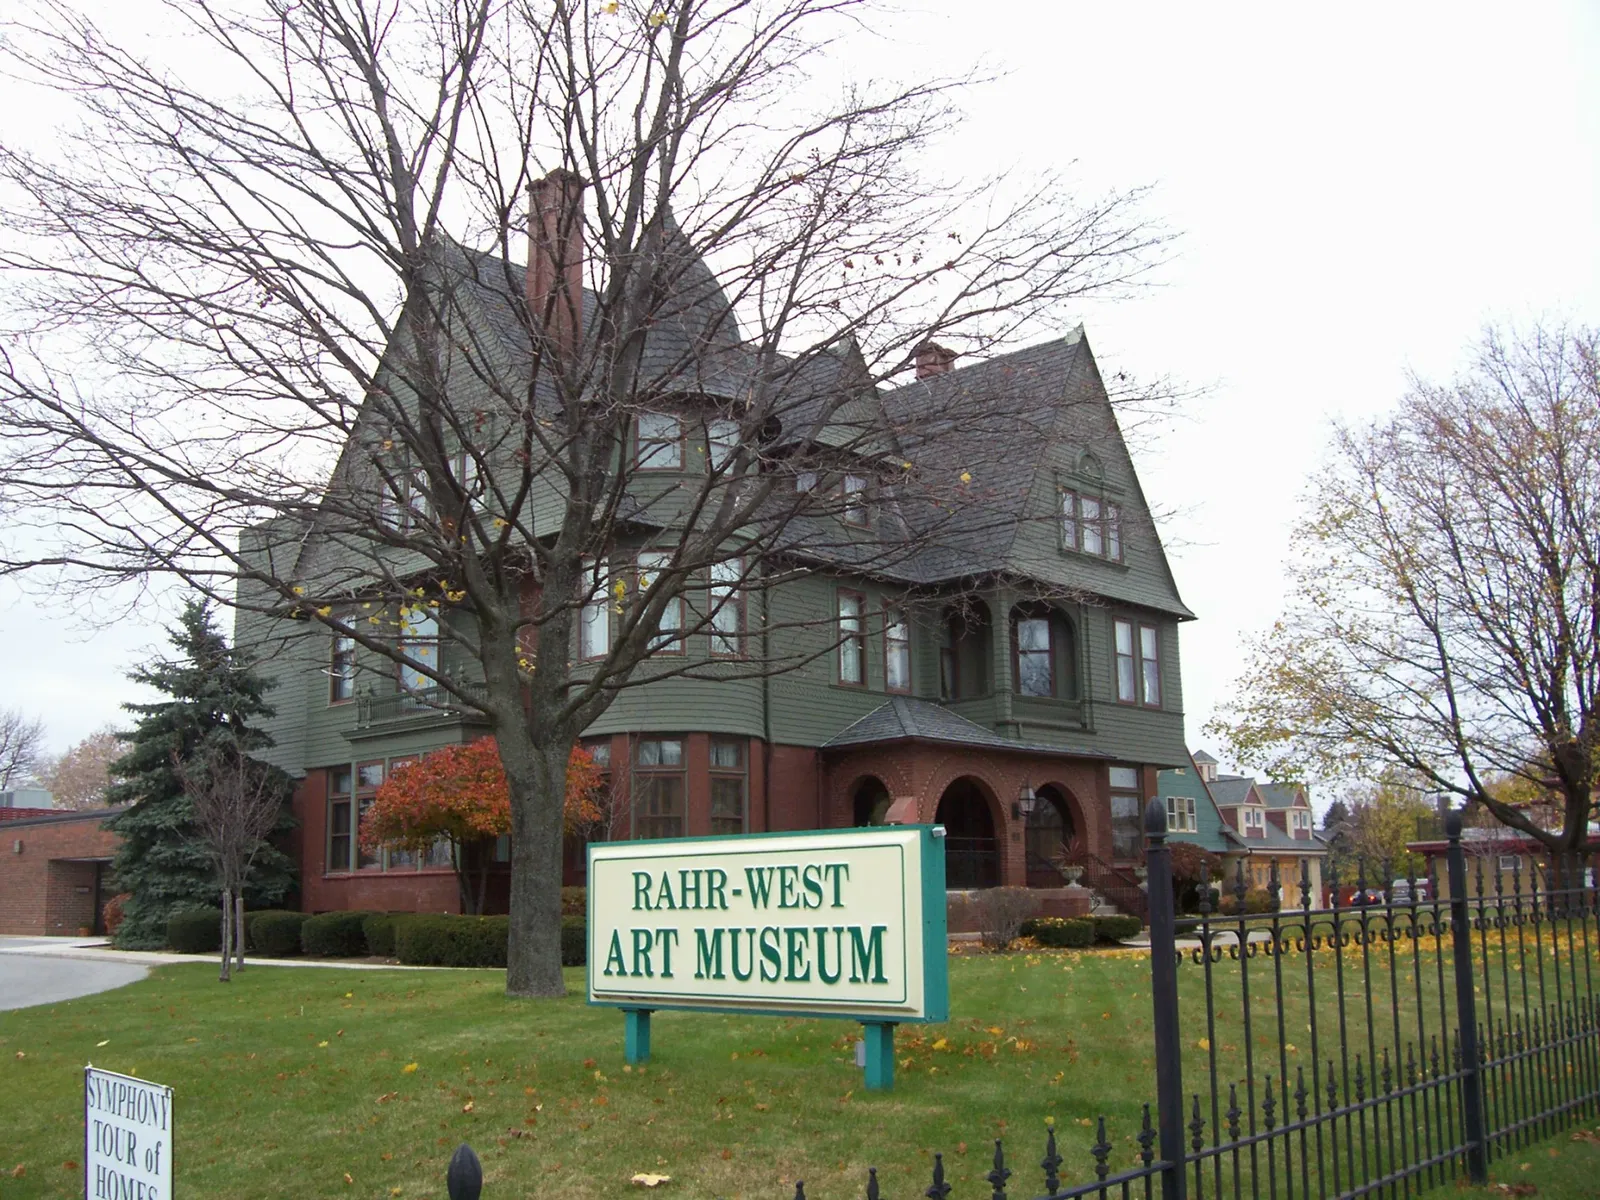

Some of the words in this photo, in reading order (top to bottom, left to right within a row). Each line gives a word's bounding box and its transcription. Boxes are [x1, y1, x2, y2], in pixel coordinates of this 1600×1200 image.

[631, 862, 850, 911] RAHR-WEST
[603, 928, 679, 978] ART
[693, 925, 888, 984] MUSEUM
[88, 1076, 170, 1131] SYMPHONY
[94, 1119, 137, 1167] TOUR
[145, 1141, 162, 1175] of
